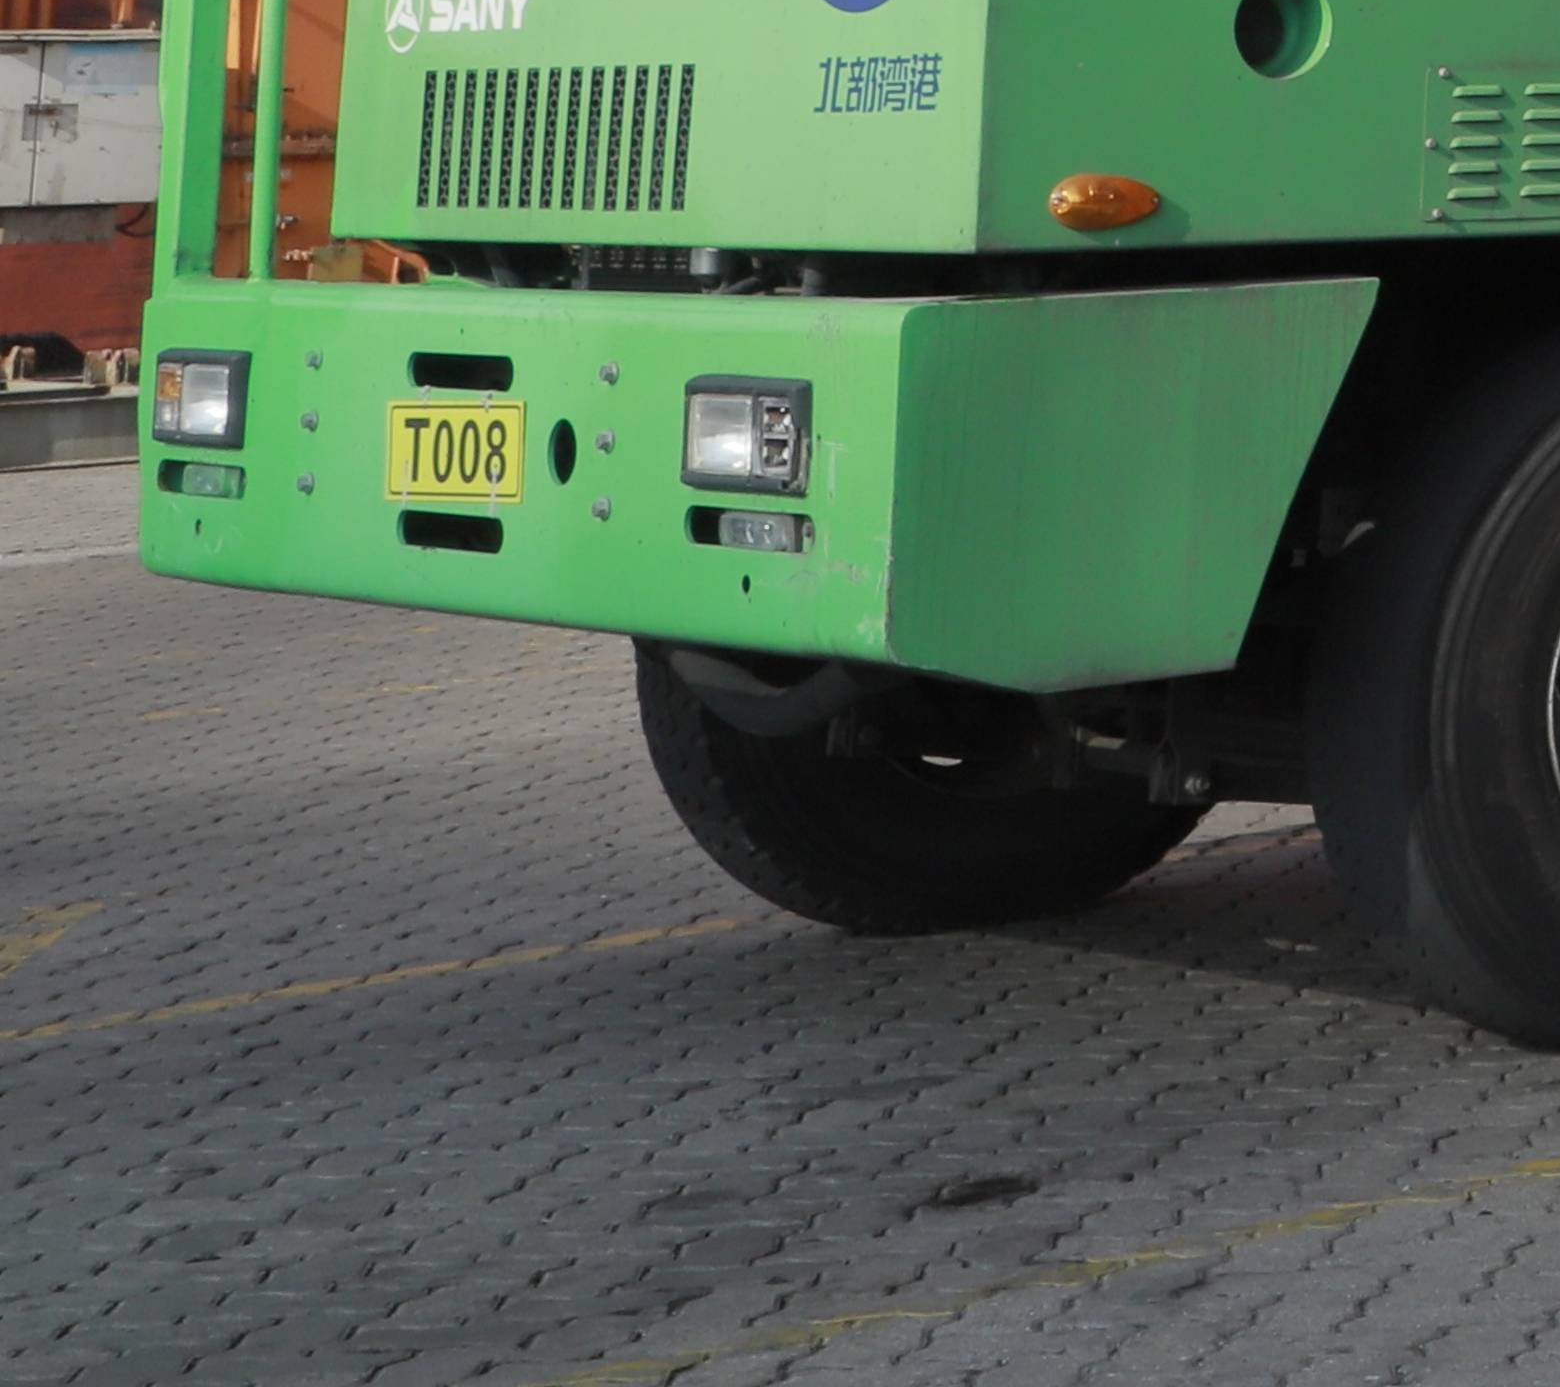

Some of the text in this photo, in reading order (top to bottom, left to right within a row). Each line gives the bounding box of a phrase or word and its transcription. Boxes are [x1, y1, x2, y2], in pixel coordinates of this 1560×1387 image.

[813, 52, 943, 114] 北部湾港
[403, 416, 508, 485] T008
